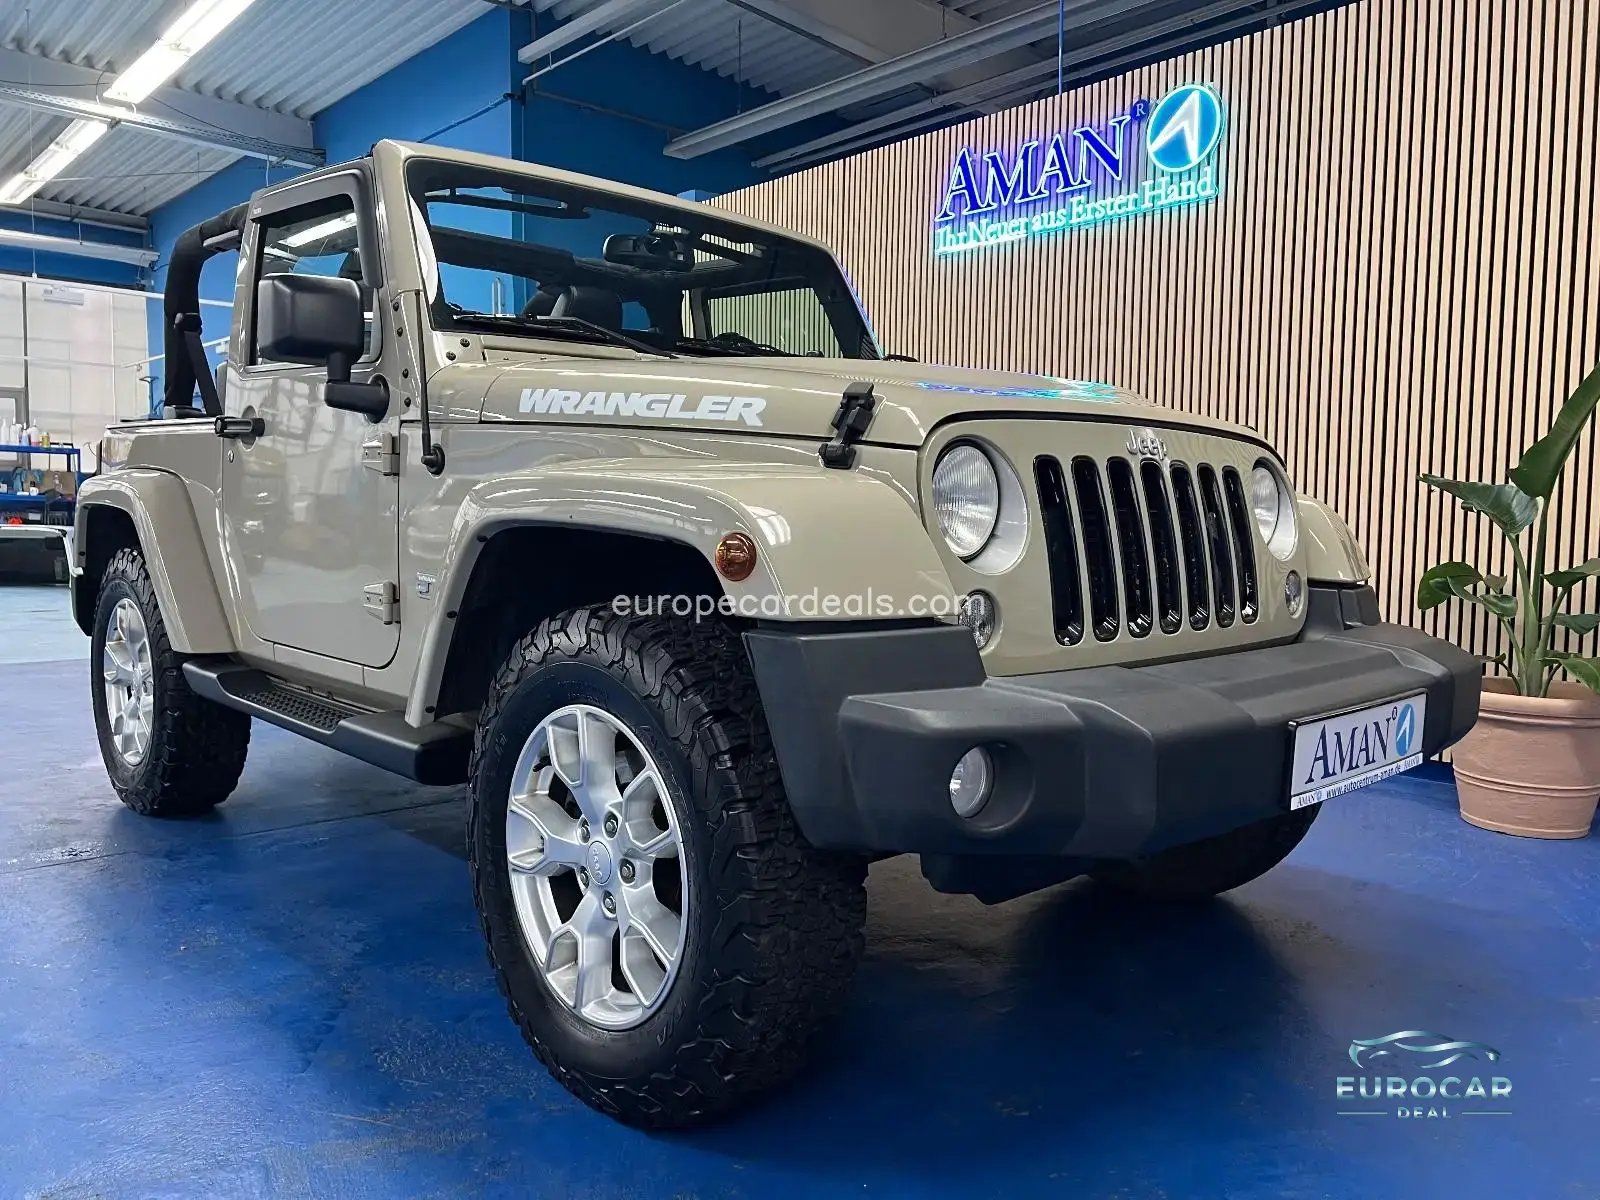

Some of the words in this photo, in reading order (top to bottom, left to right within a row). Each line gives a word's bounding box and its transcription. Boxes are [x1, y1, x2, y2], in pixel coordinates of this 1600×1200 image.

[934, 115, 1131, 222] AMAN
[966, 217, 1029, 245] Neuer
[1031, 208, 1067, 232] aus
[1069, 194, 1139, 225] Erster
[1141, 165, 1214, 209] Hand
[519, 388, 767, 427] WRANGLER
[1126, 427, 1168, 460] Jeep
[1304, 717, 1392, 785] AMAN
